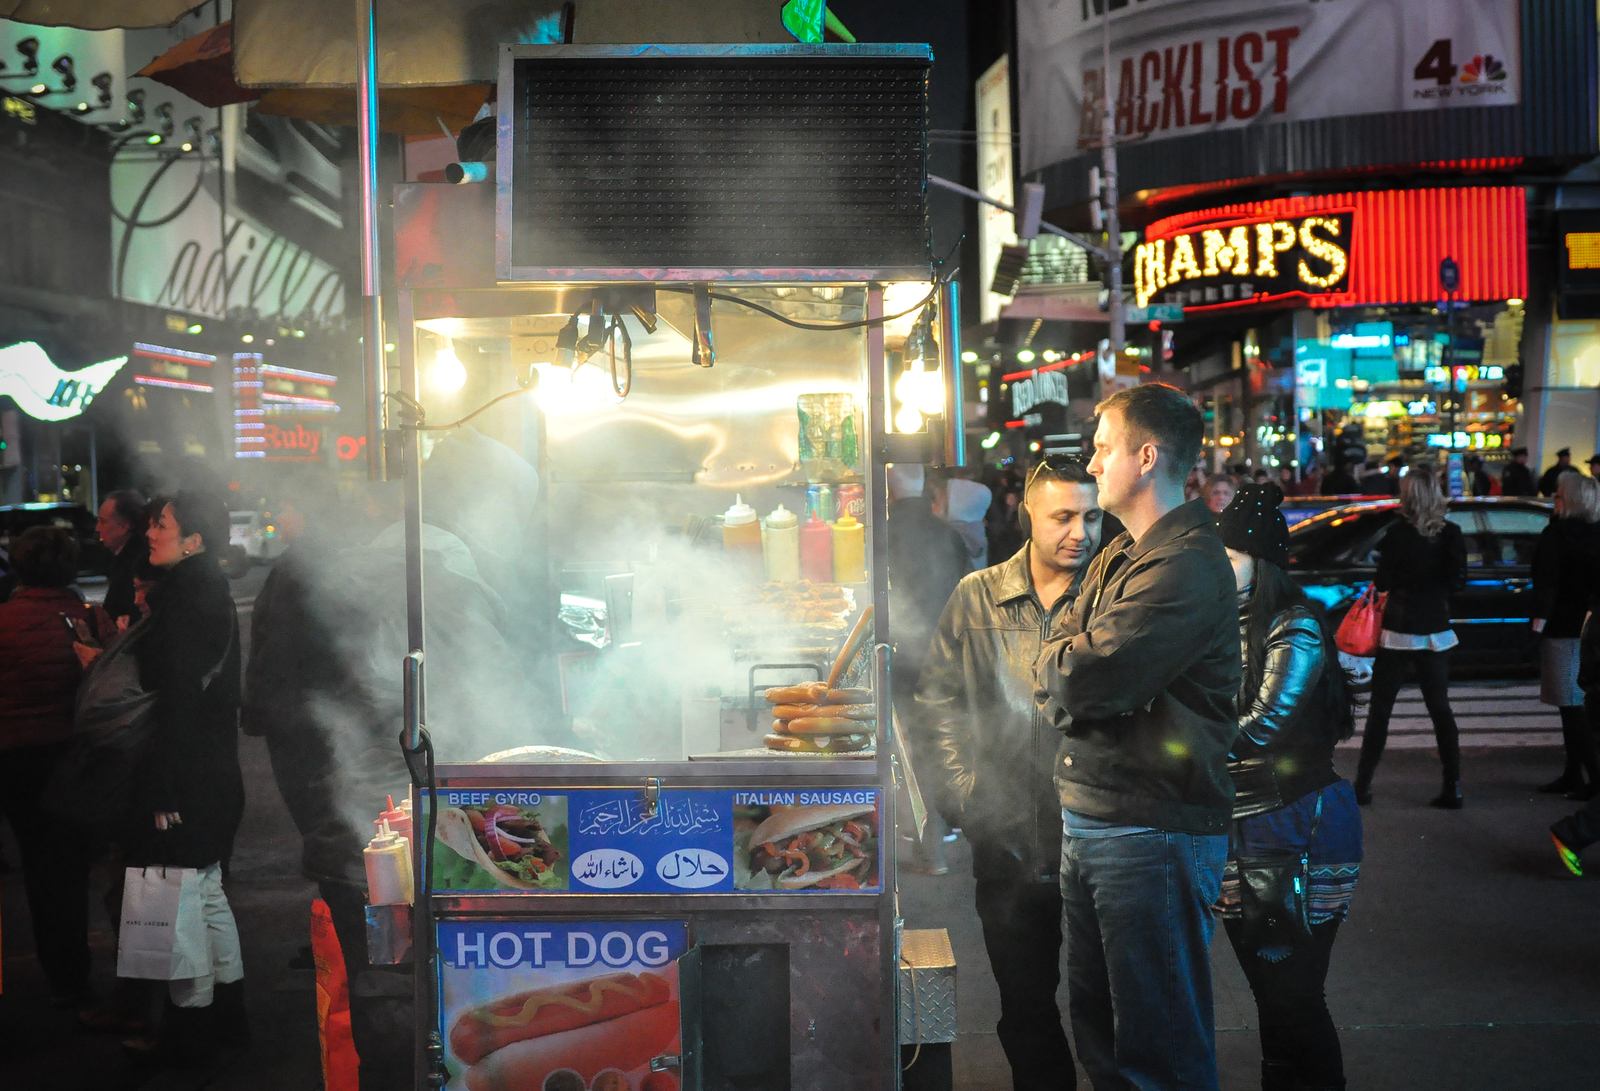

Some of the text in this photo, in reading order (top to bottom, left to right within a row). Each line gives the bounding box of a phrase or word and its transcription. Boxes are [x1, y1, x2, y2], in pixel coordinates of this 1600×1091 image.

[1414, 38, 1457, 86] 4
[1078, 26, 1300, 150] BACKLIST
[1456, 84, 1506, 96] YORK
[449, 792, 541, 805] BEEF GYRO
[735, 792, 875, 805] ITALIAN SAUSAGE
[662, 853, 725, 880] حلال
[456, 931, 669, 967] HOT DOG
